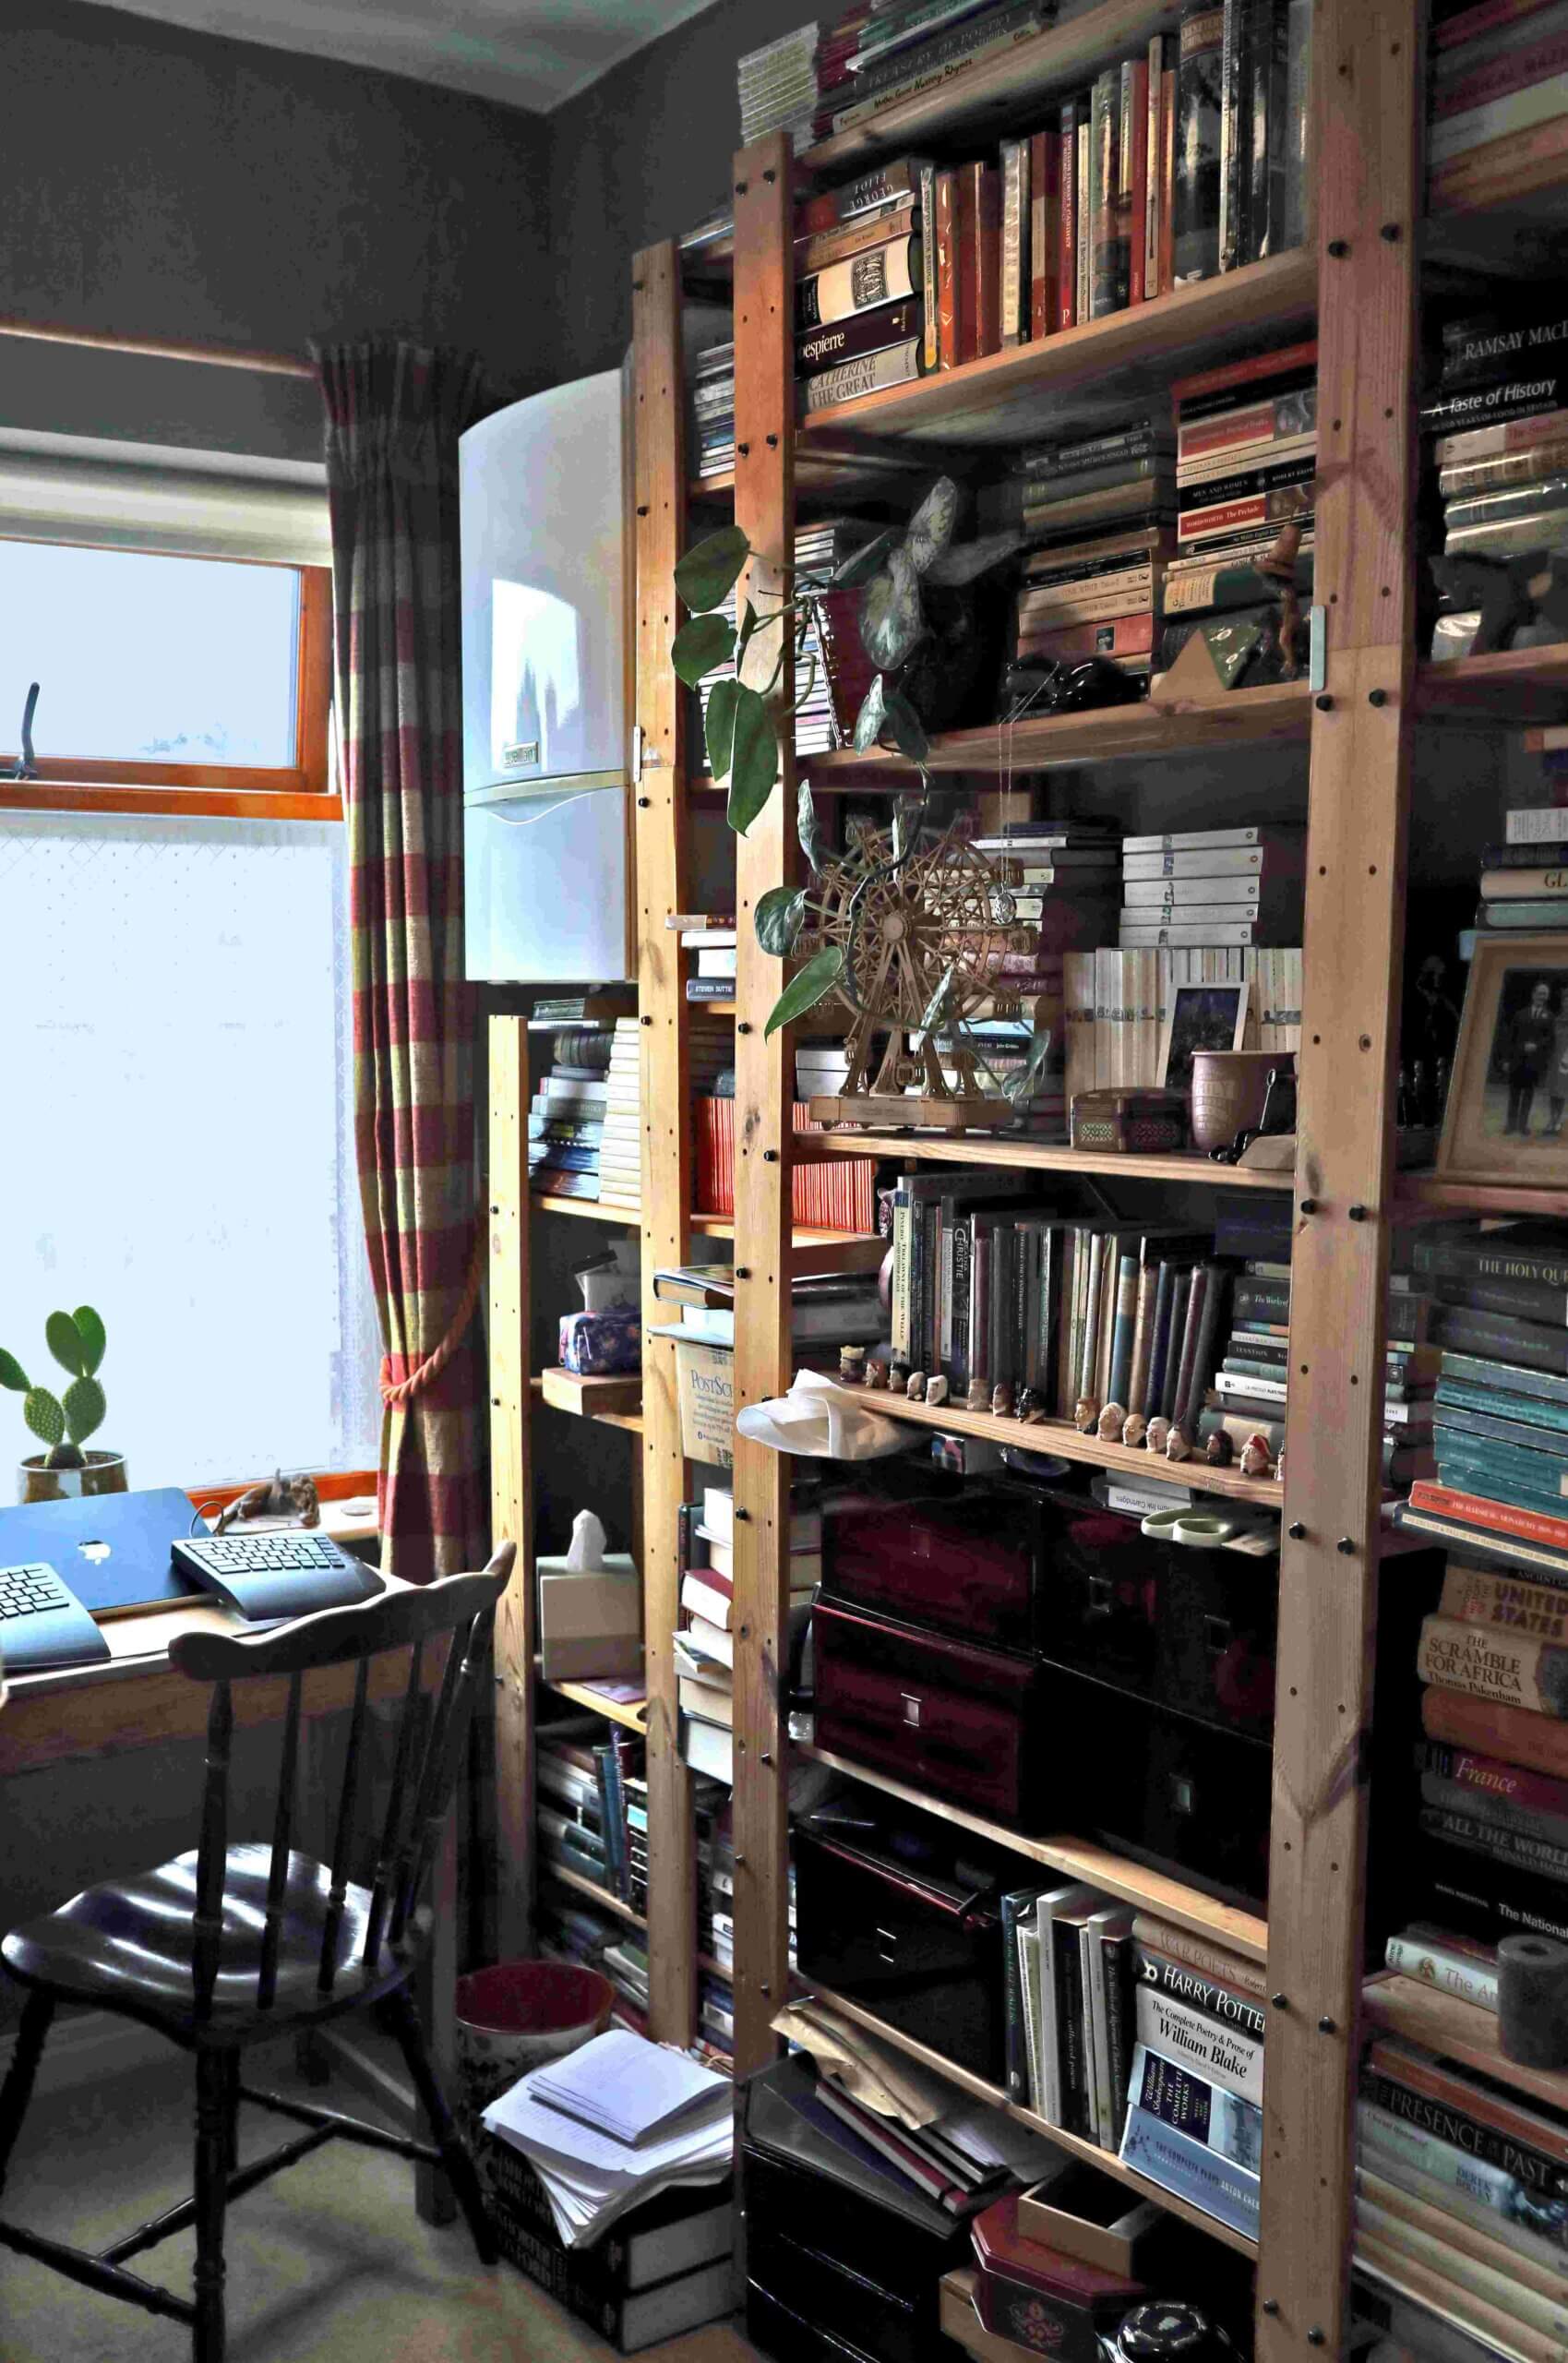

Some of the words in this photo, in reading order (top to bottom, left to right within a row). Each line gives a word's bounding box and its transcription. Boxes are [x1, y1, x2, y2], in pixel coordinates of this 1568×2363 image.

[915, 73, 942, 91] Nursery
[944, 58, 974, 78] Rhymes
[850, 185, 893, 210] GEORGE
[855, 173, 887, 196] ELIOT
[1465, 330, 1526, 361] RAMSAY
[808, 355, 878, 392] CATHERINE
[811, 386, 836, 409] THE
[836, 372, 878, 401] GREAT
[1449, 395, 1483, 414] Taste
[1486, 388, 1502, 406] of
[1504, 378, 1558, 402] History
[1238, 504, 1261, 518] Prelude
[954, 1228, 966, 1278] CHRISTIE
[1478, 1258, 1503, 1274] THE
[1505, 1261, 1539, 1278] HOLY
[1116, 1495, 1146, 1509] Cartridges
[1495, 1580, 1568, 1616] UNITED
[1492, 1604, 1564, 1638] STATES
[1429, 1637, 1522, 1676] SCRAMBLE
[1466, 1634, 1490, 1649] THE
[1425, 1653, 1457, 1675] FOR
[1460, 1662, 1523, 1692] AFRICA
[1430, 1672, 1466, 1690] Thomas
[1468, 1682, 1522, 1705] Pakenham
[1454, 1757, 1517, 1794] France
[1442, 1814, 1474, 1837] ALL
[1478, 1824, 1512, 1849] THE
[1498, 1901, 1520, 1922] The
[1521, 1911, 1568, 1938] National
[1163, 1964, 1215, 2007] HARRY
[1445, 1967, 1474, 1993] The
[1066, 2019, 1076, 2058] collected
[1152, 2000, 1165, 2014] The
[1166, 2007, 1196, 2030] Complete
[1196, 2023, 1218, 2043] Poetry
[1218, 2034, 1226, 2045] &
[1226, 2038, 1245, 2056] Prose
[1245, 2050, 1255, 2061] of
[1159, 2018, 1207, 2058] William
[1210, 2046, 1248, 2080] Blake
[1067, 2060, 1076, 2089] poems
[1166, 2082, 1175, 2104] THE
[1172, 2069, 1185, 2126] COMPLETE
[1179, 2082, 1191, 2120] WORKS
[1390, 2088, 1486, 2157] PRESENCE
[1502, 2145, 1551, 2187] PAST
[1155, 2141, 1167, 2153] THE
[1167, 2148, 1200, 2175] COMPLETE
[1220, 2179, 1242, 2201] ANTON
